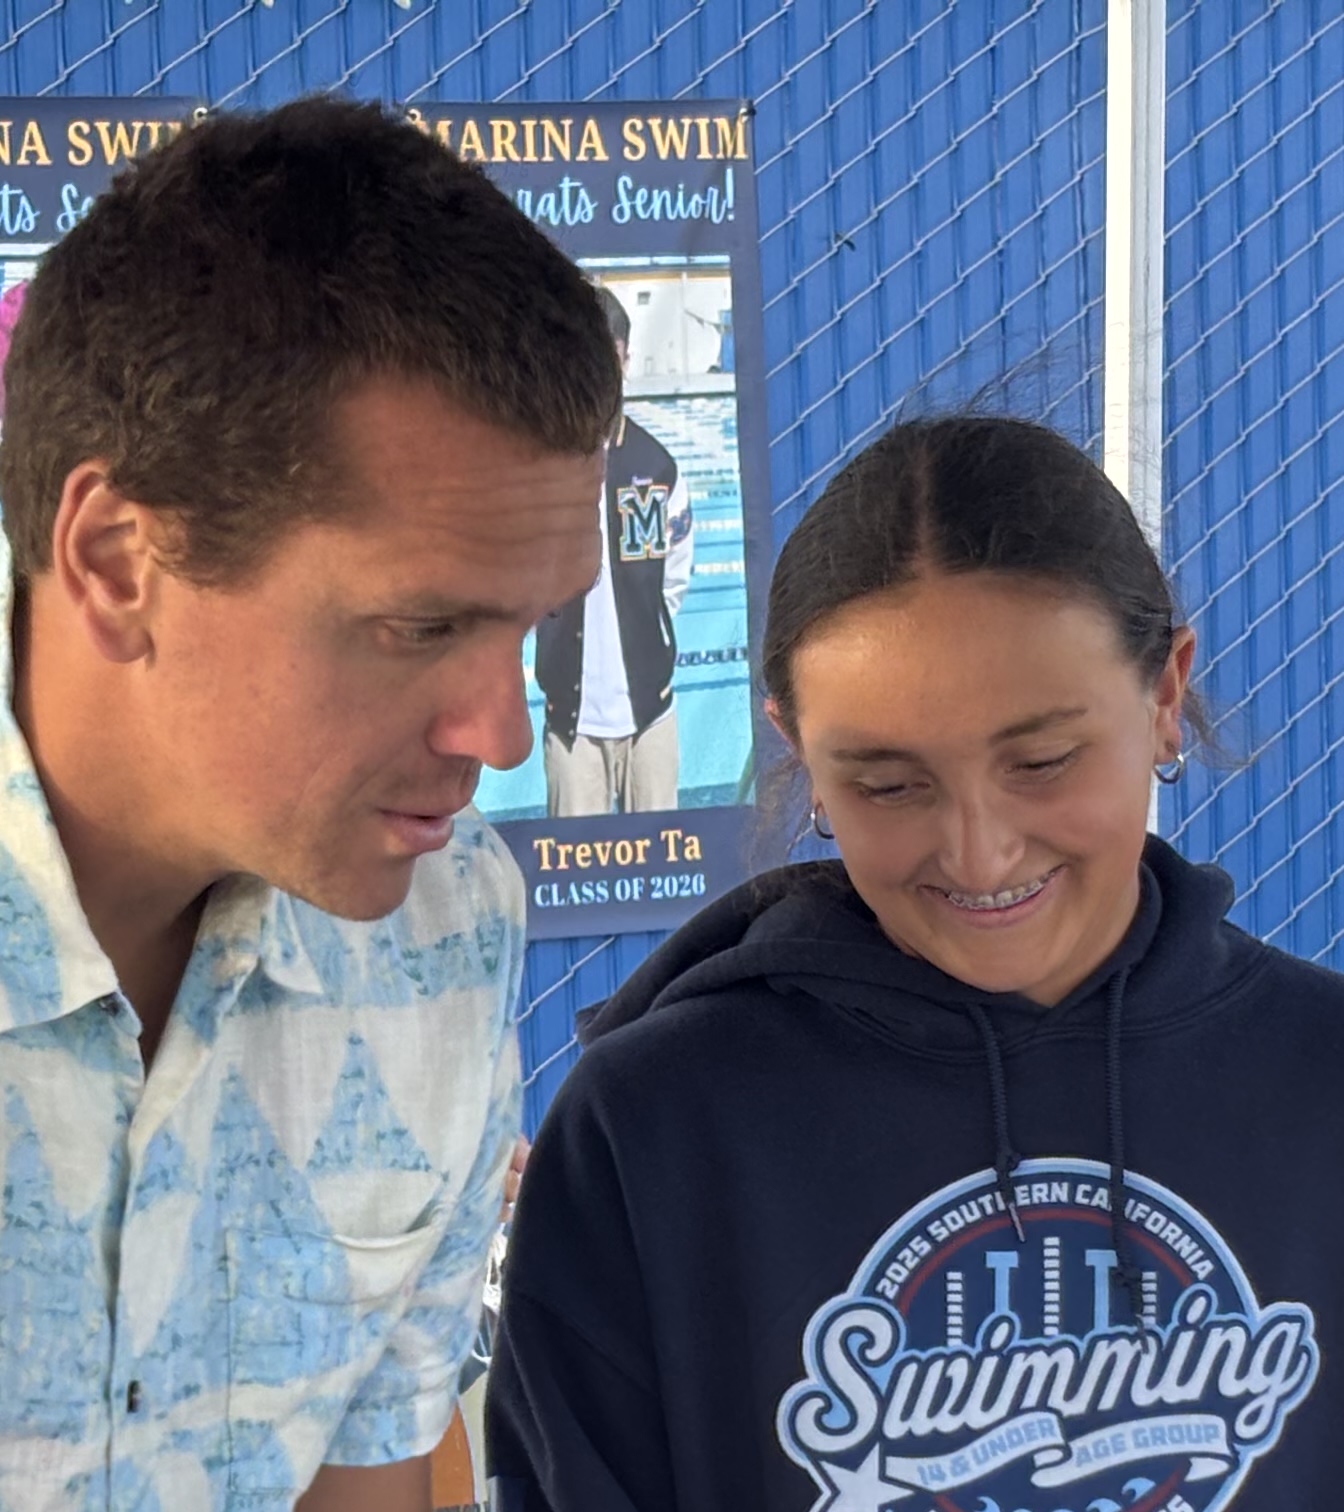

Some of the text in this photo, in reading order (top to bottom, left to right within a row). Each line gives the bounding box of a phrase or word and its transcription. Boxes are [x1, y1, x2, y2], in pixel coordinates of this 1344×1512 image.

[66, 120, 183, 166] SWI
[621, 117, 749, 161] SWIM
[514, 166, 735, 227] rats Senior!
[616, 484, 670, 562] M
[532, 828, 703, 872] Trevor Ta
[534, 872, 706, 909] CLASS OF 2026
[875, 1234, 933, 1300] 2025
[1074, 1183, 1215, 1281] CAIFORNIA
[795, 1294, 1310, 1452] Swimming
[916, 1416, 1222, 1486] 14 & UNDER AGE GROUP
